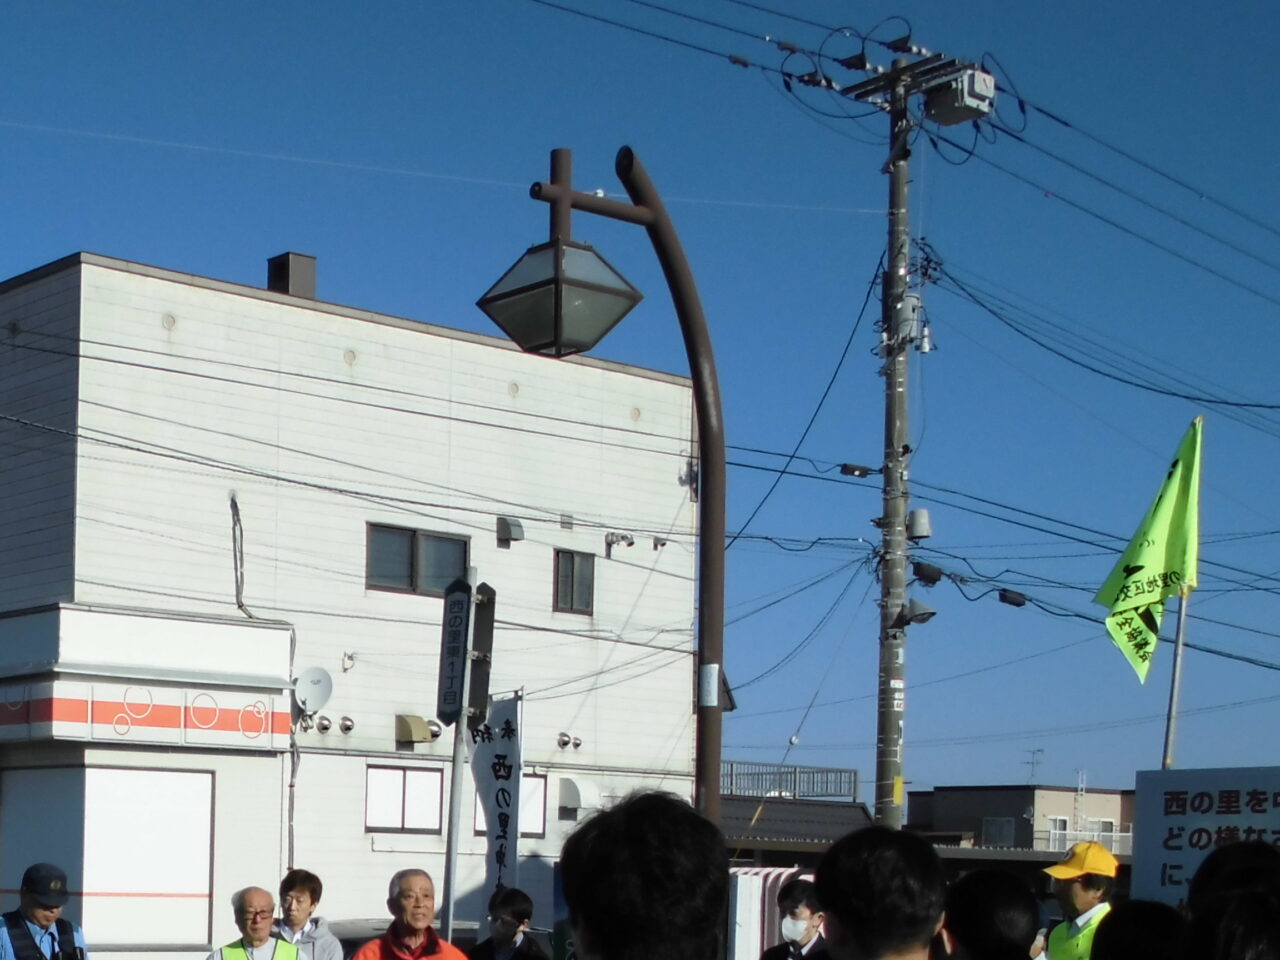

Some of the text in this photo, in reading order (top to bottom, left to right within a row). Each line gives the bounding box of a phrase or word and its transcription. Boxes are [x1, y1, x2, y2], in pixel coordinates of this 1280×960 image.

[442, 600, 464, 705] 西の里東1丁目
